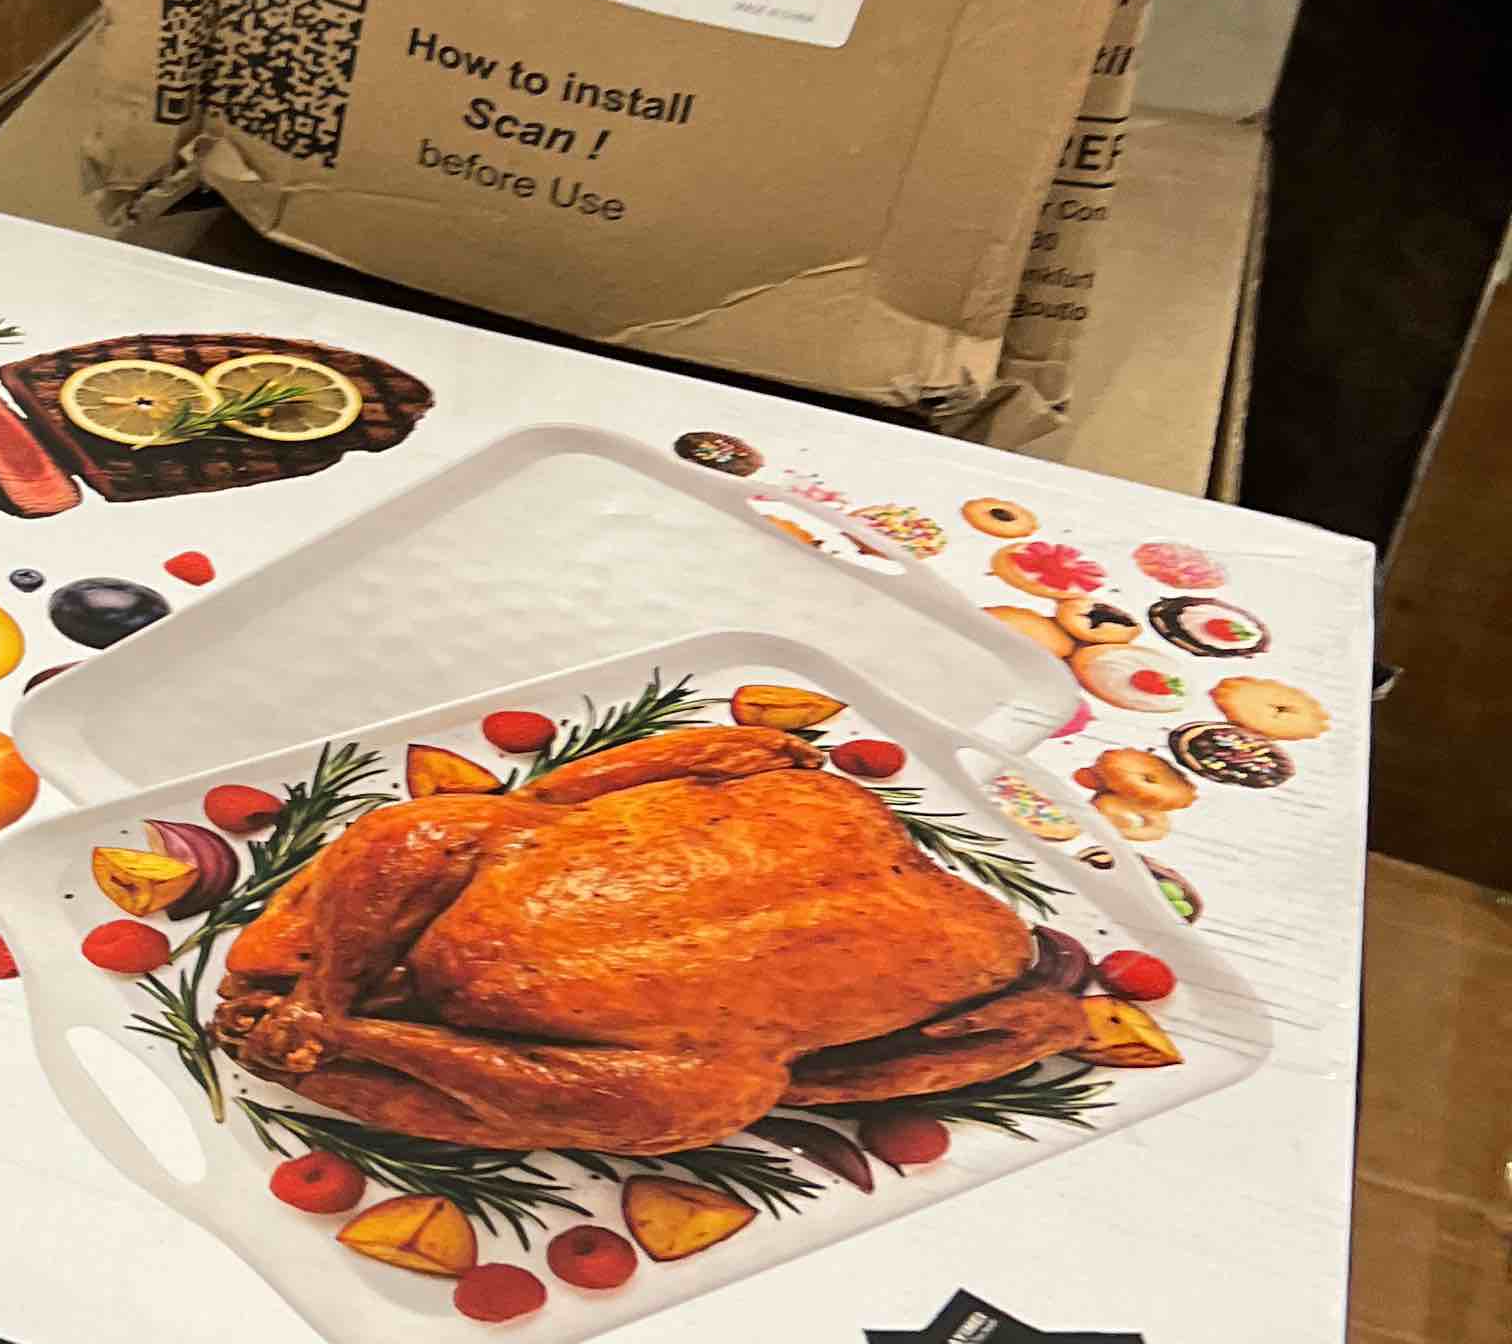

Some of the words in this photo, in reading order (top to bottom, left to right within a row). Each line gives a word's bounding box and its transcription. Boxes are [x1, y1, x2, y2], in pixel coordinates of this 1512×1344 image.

[408, 27, 498, 80] How
[509, 60, 549, 96] to
[560, 71, 696, 125] install
[462, 97, 576, 154] Scan
[416, 138, 536, 198] before
[549, 176, 626, 221] Use
